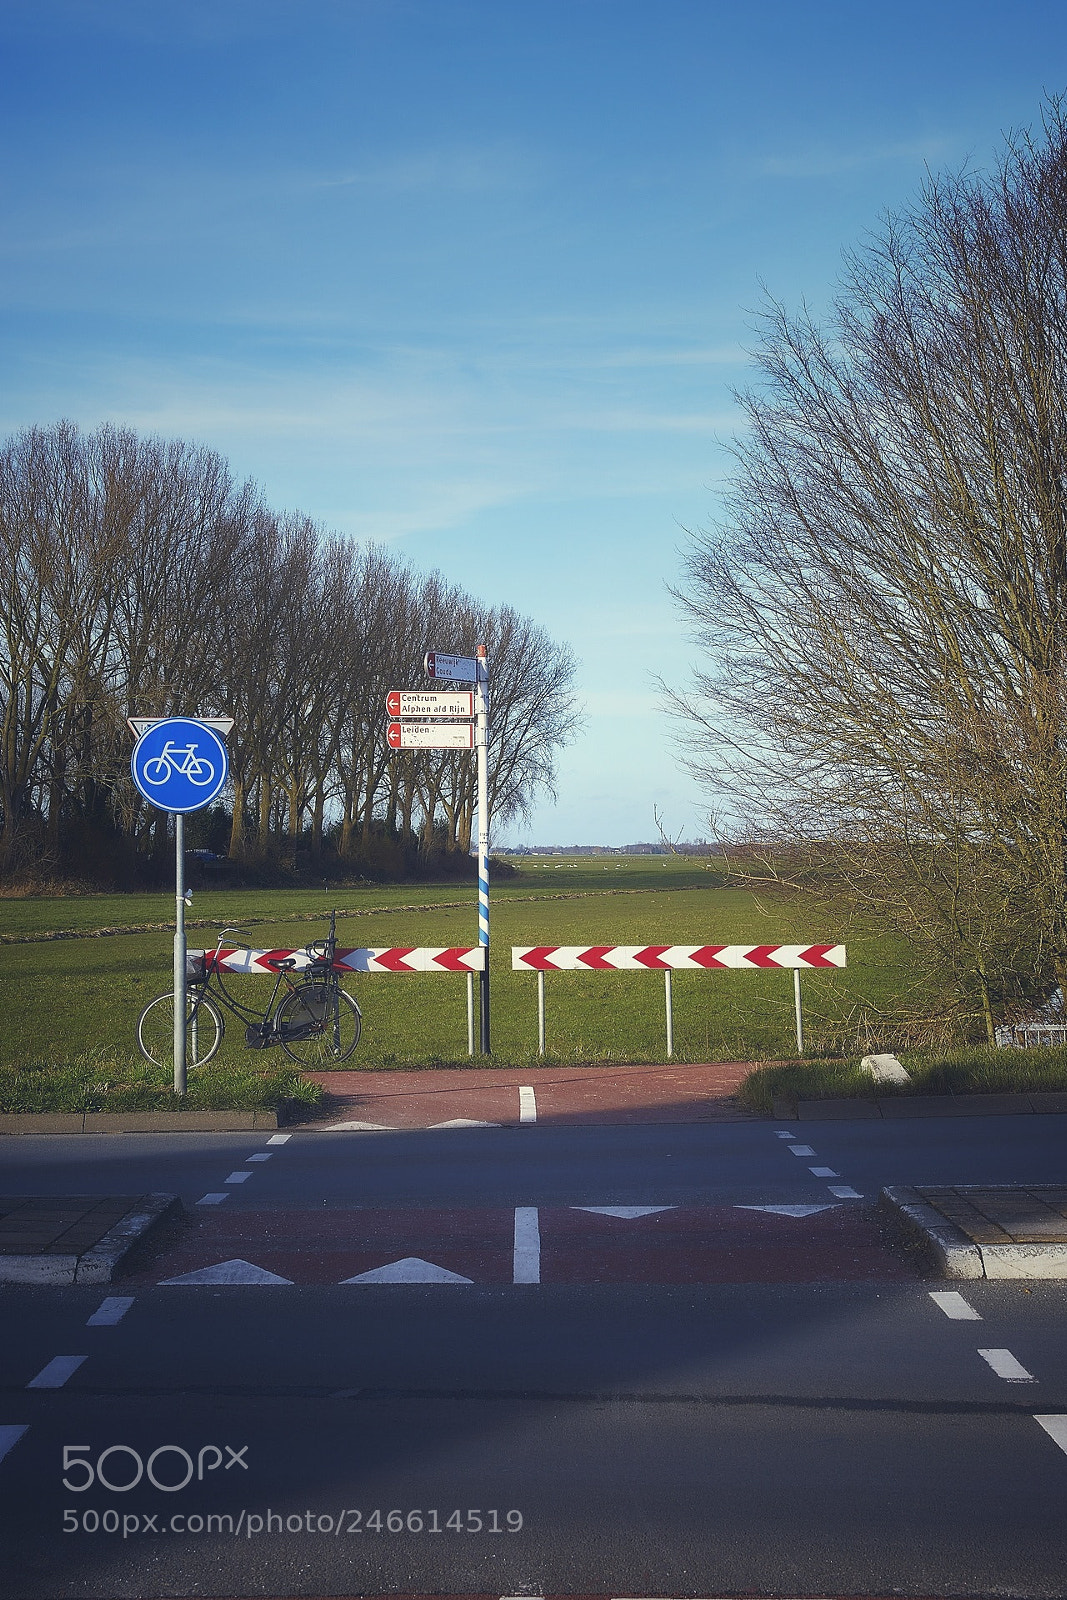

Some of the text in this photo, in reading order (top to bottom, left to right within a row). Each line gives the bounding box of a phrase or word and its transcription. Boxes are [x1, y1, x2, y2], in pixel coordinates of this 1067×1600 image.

[401, 694, 437, 702] Centrum
[401, 705, 431, 714] Alphen
[449, 705, 465, 714] Rijn
